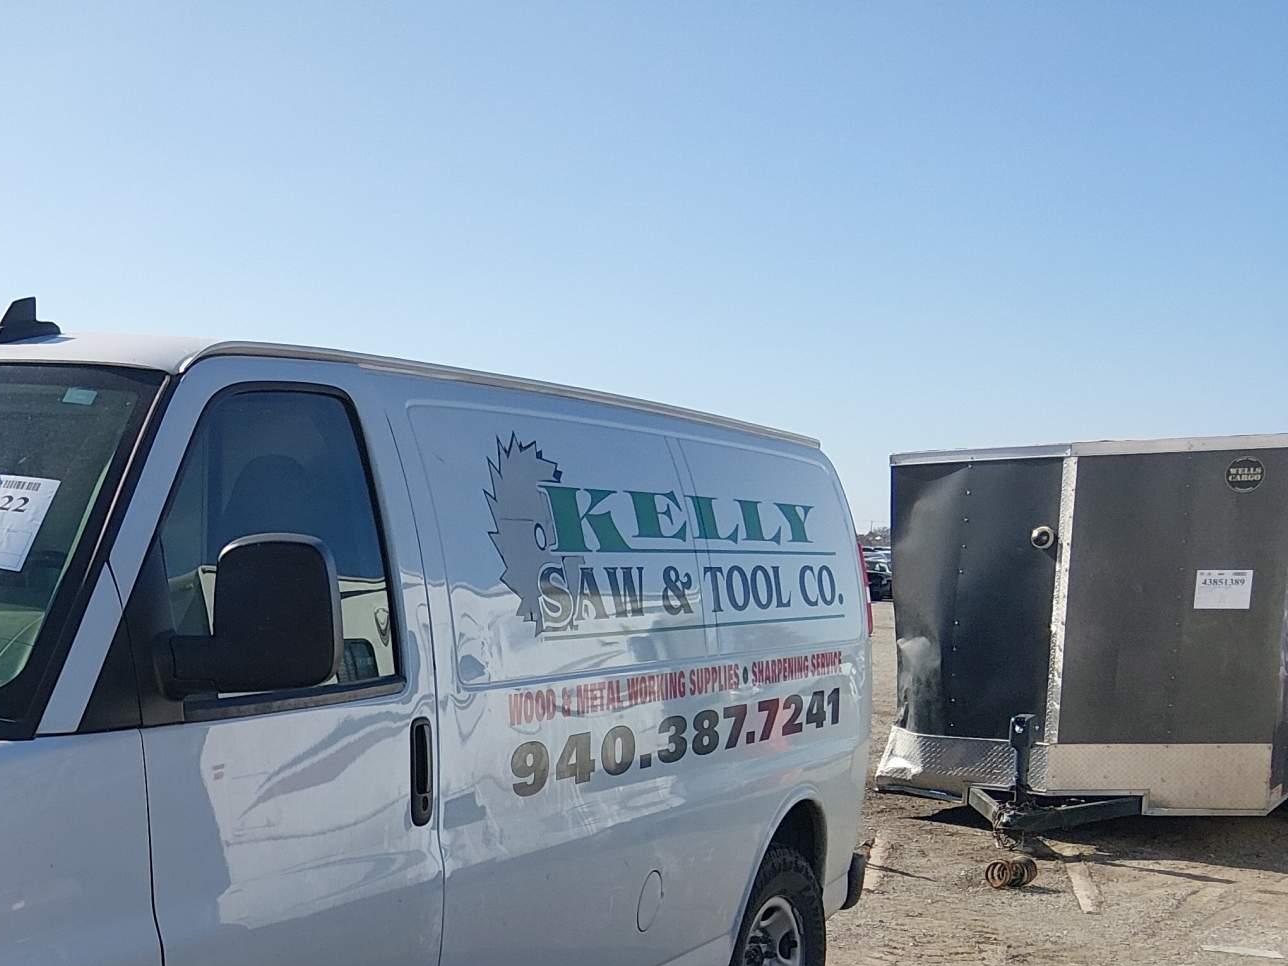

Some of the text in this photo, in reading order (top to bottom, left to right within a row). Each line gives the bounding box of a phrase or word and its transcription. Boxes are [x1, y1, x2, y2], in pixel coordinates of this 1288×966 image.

[1229, 474, 1261, 482] CARGO
[538, 485, 815, 553] KELLY
[538, 564, 844, 631] SAW & TOOL CO.
[508, 651, 842, 727] WOOD & METAL WORKING SUPPLIES SHARPENING SERVICE
[510, 687, 841, 798] 940.387.7241
